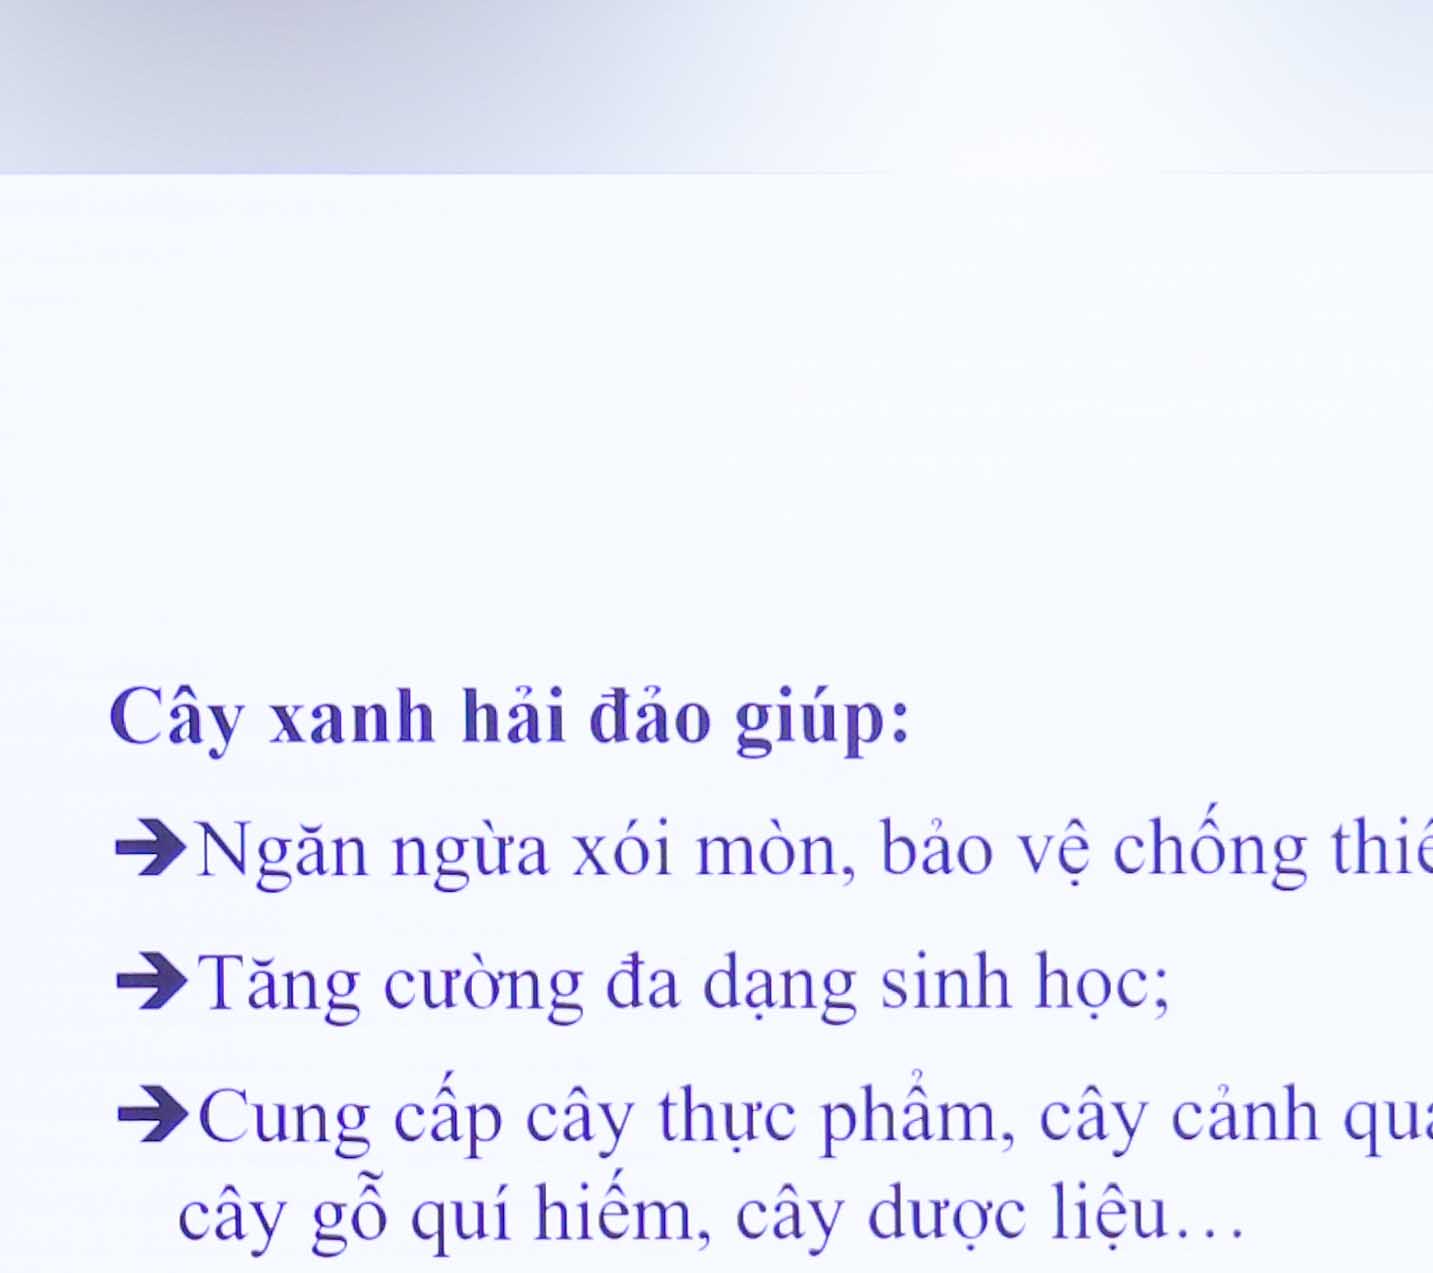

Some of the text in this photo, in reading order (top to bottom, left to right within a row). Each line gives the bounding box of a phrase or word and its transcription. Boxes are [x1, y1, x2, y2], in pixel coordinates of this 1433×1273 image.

[110, 684, 908, 762] Cây xanh hải đảo giúp:
[194, 821, 370, 895] Ngăn
[393, 819, 551, 895] ngừa
[574, 817, 672, 877] xói
[698, 819, 856, 887] mòn,
[880, 817, 994, 877] bảo
[1018, 818, 1091, 888] vệ
[1115, 802, 1309, 893] chống
[198, 950, 1169, 1029] Tăng cường đa dạng sinh học;
[200, 1088, 372, 1161] Cung
[395, 1070, 504, 1161] cấp
[527, 1086, 636, 1161] cây
[659, 1084, 796, 1155] thực
[821, 1069, 1016, 1160] phẩm,
[1041, 1085, 1150, 1160] cây
[1173, 1083, 1321, 1142] cảnh
[179, 1184, 289, 1260] cây
[312, 1170, 389, 1260] gỗ
[412, 1184, 512, 1260] quí
[536, 1168, 712, 1252] hiếm,
[737, 1183, 846, 1258] cây
[869, 1182, 1026, 1253] dược
